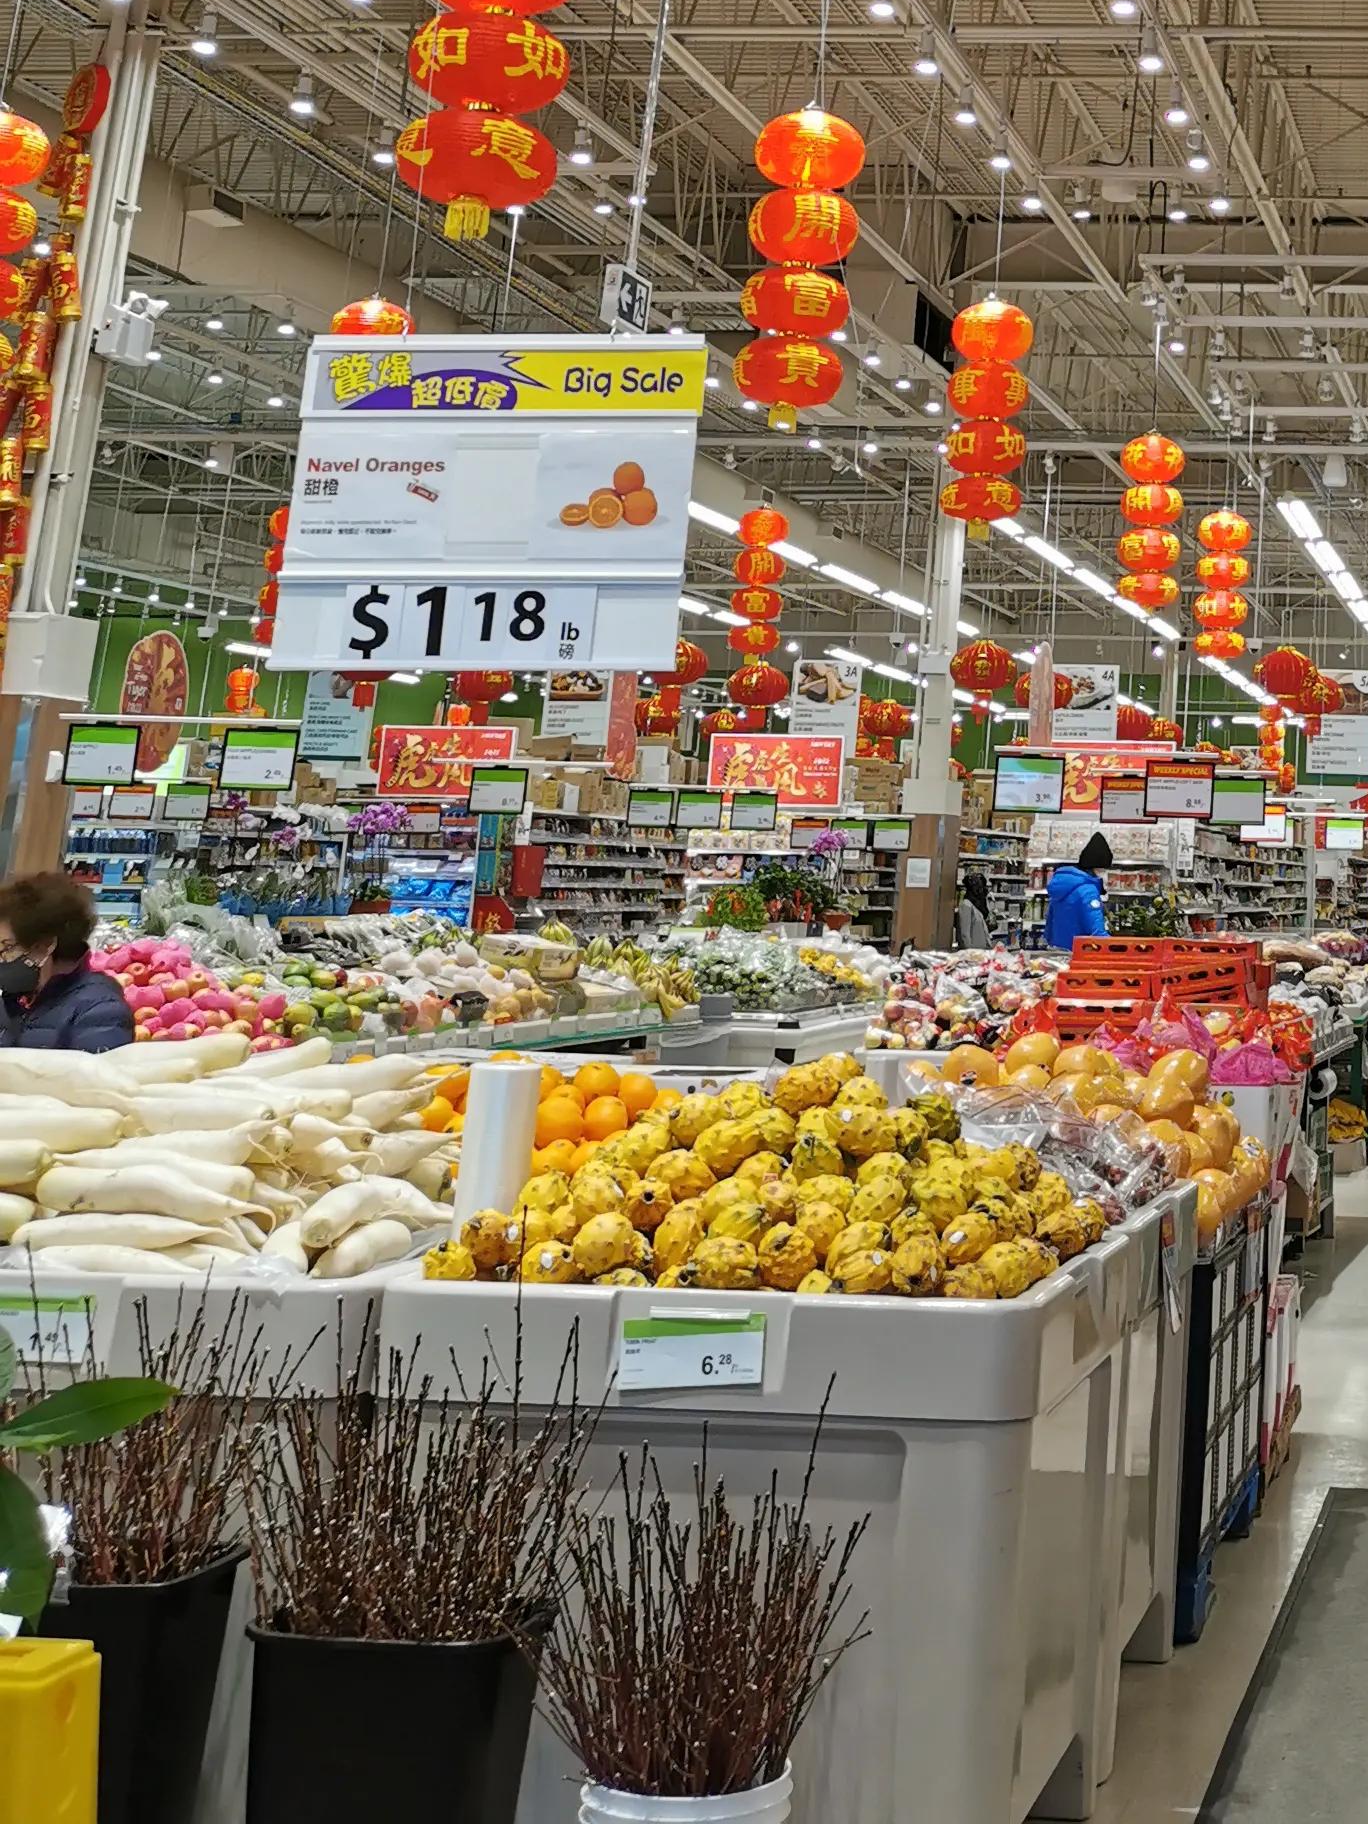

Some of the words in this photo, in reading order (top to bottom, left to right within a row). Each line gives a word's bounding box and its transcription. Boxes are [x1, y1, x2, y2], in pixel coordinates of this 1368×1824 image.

[564, 368, 611, 397] Big
[621, 367, 684, 394] Sale
[307, 458, 360, 472] Navel
[366, 458, 446, 475] Oranges
[304, 479, 339, 496] 甜橙
[561, 622, 580, 640] lb
[558, 643, 575, 659] 磅
[845, 666, 857, 677] 3A
[1102, 670, 1114, 681] 4A
[702, 1354, 733, 1375] 6.28
